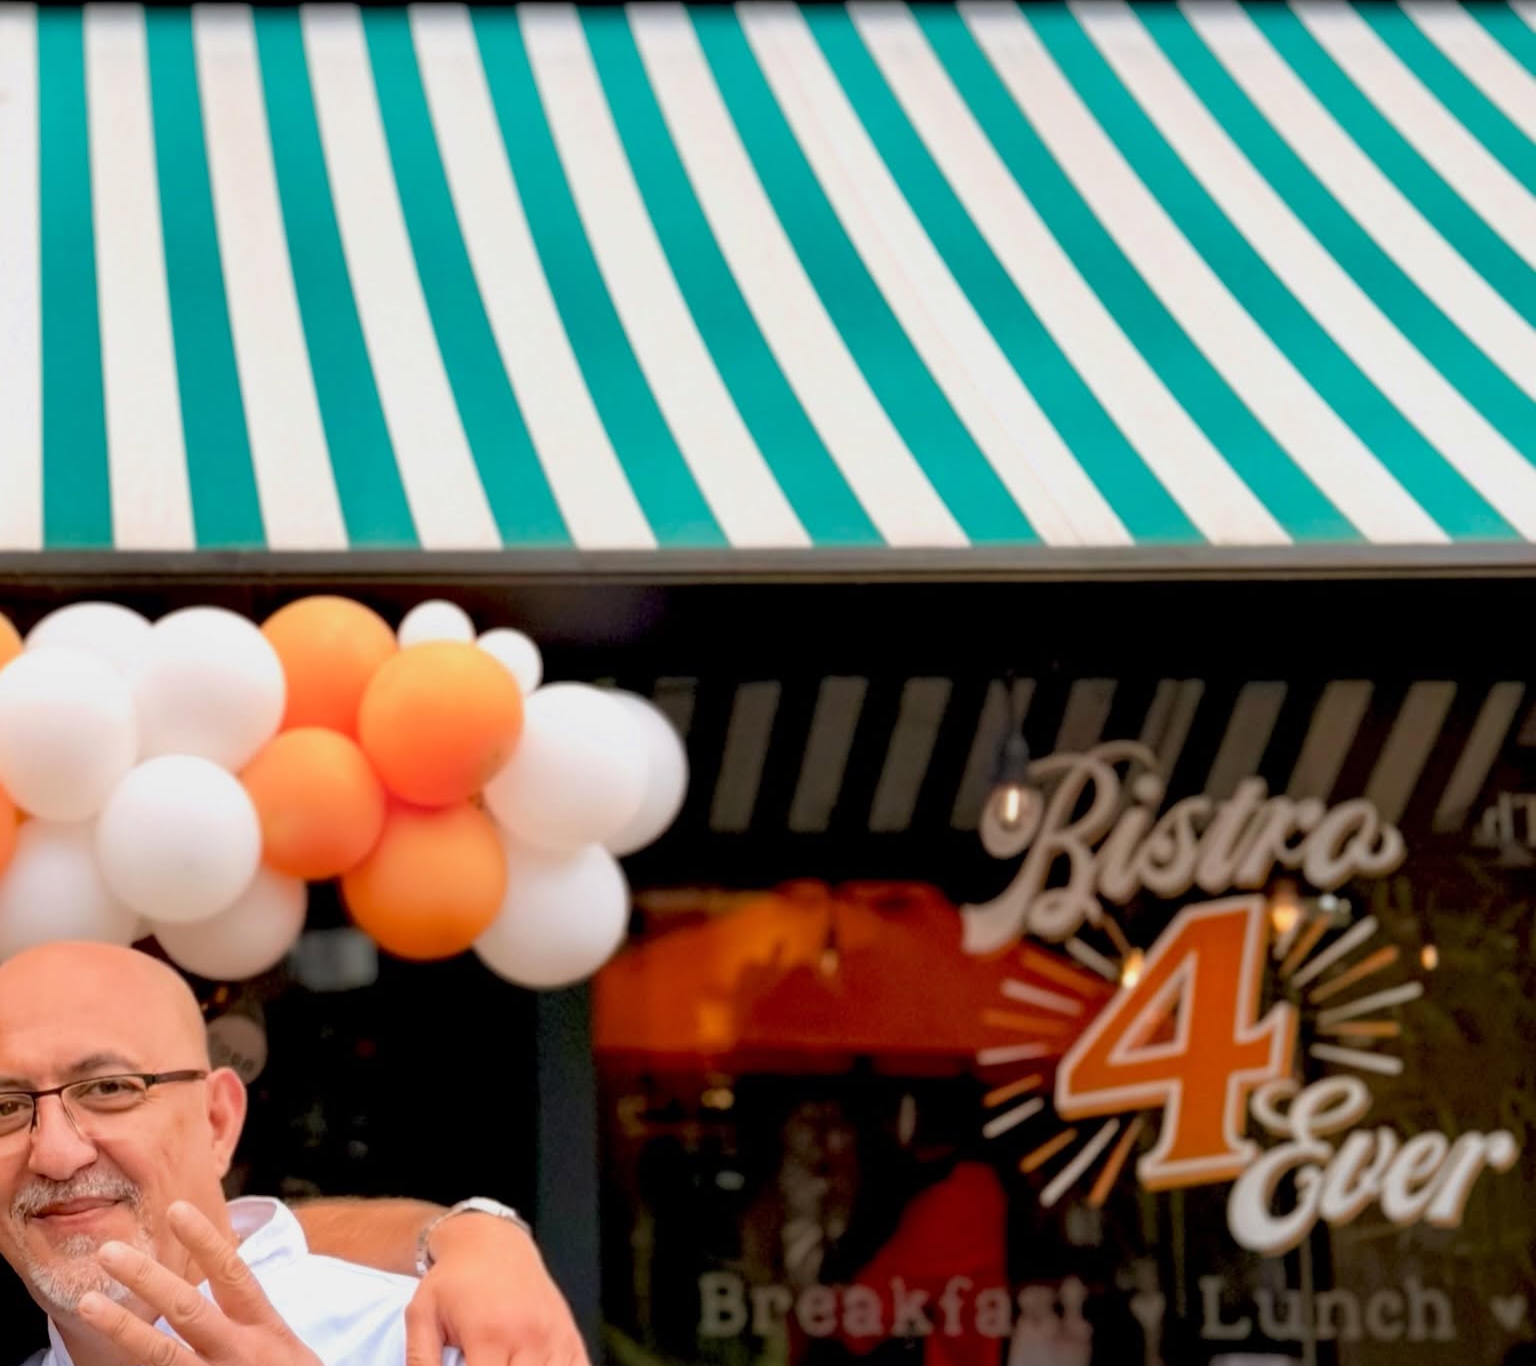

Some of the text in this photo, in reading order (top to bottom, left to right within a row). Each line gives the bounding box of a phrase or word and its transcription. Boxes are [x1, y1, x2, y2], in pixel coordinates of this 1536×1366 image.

[961, 739, 1406, 955] Bistro
[1054, 893, 1300, 1193] 4
[1227, 1076, 1518, 1255] Ever
[698, 1270, 1457, 1341] Breakfast Lunch
